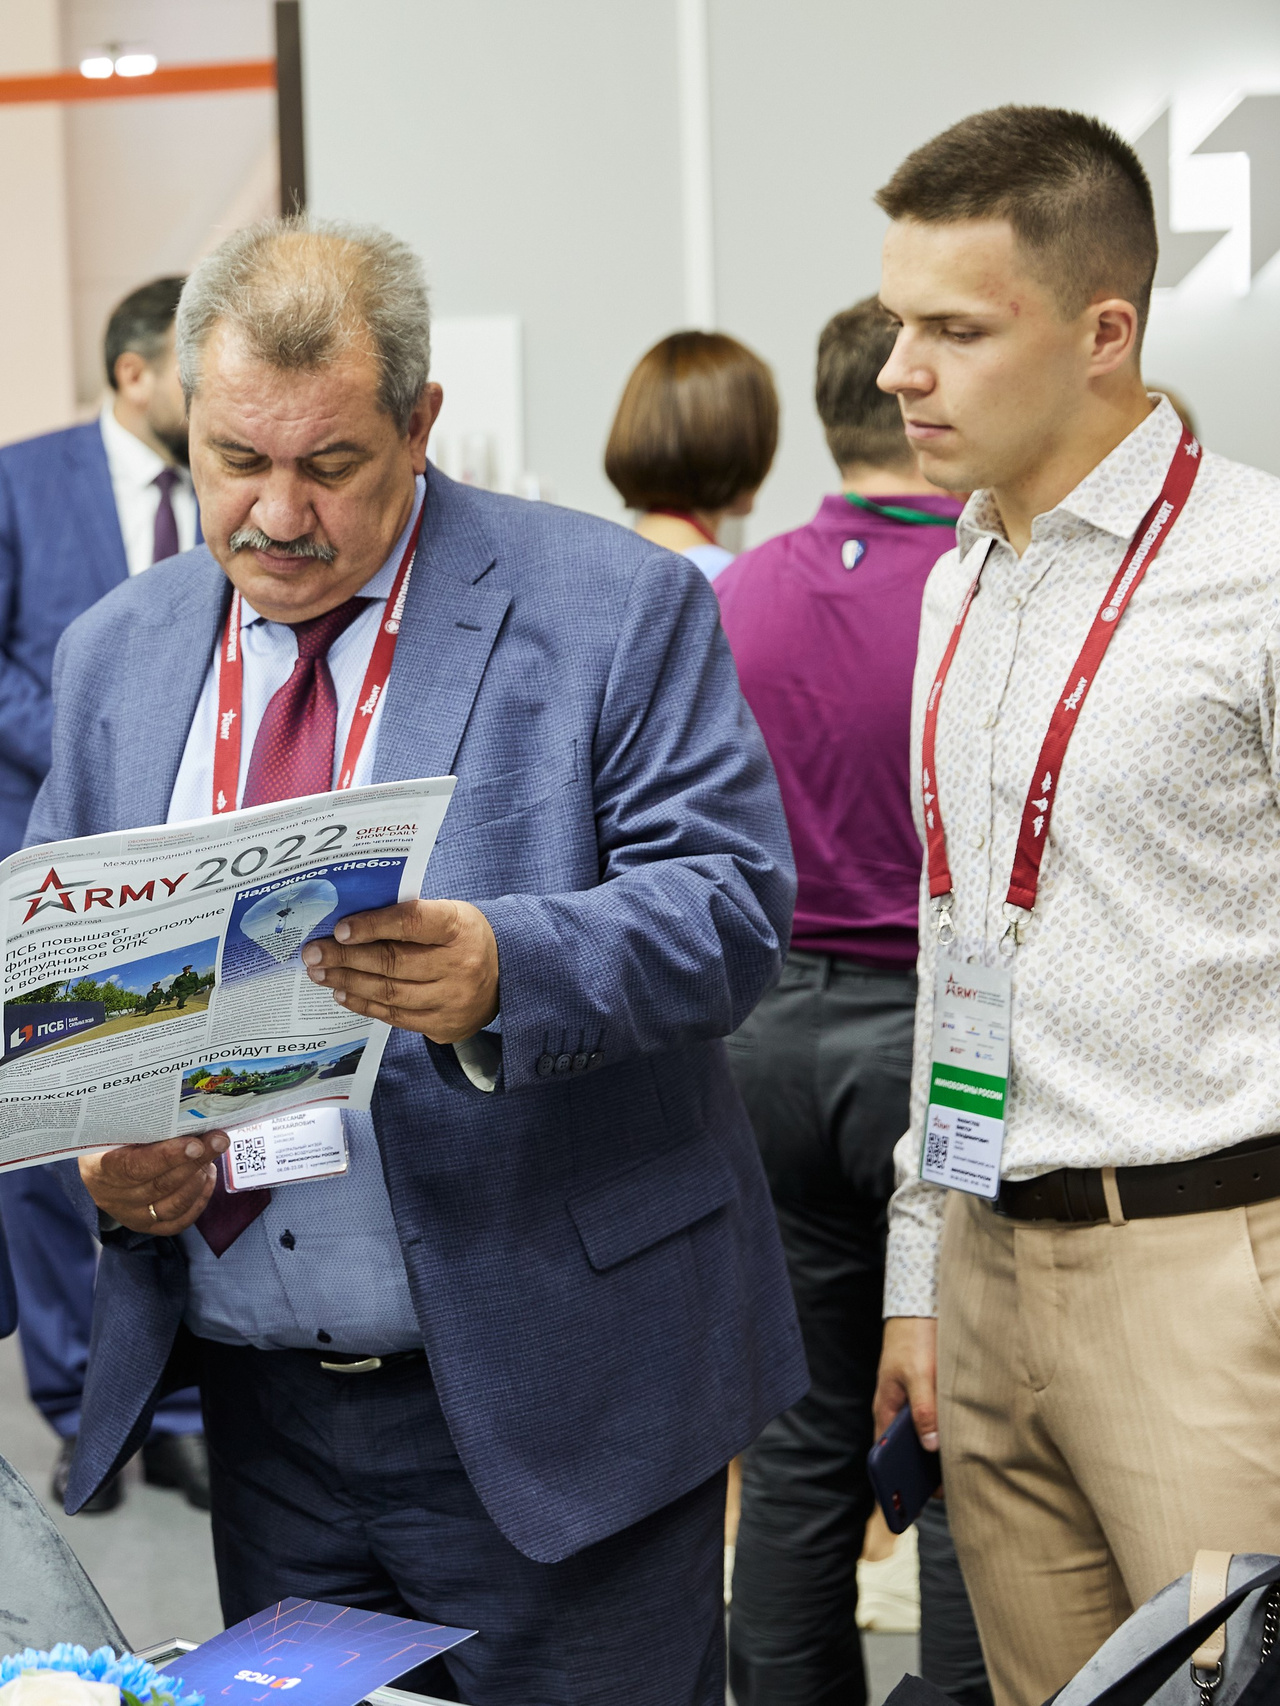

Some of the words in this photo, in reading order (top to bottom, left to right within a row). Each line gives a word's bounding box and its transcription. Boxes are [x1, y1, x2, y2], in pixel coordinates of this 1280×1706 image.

[1110, 500, 1174, 606] ROSOBORONEXPORT
[103, 849, 192, 868] Международный
[195, 822, 299, 854] военно-технический
[301, 813, 336, 826] форум
[352, 840, 371, 848] ДЕНЬ
[372, 837, 414, 845] ЧЕТВЕРТЫЙ
[355, 830, 418, 841] SHOW-DAILY
[356, 823, 419, 836] OFFICIAL
[20, 867, 189, 925] ARMY
[190, 824, 348, 891] 2022
[215, 870, 277, 893] ОФИЦИАЛЬНОЕ
[279, 857, 330, 874] ЕЖЕДНЕВНОЕ
[332, 850, 371, 860] ИЗДАНИЕ
[372, 846, 409, 854] ФОРУМА
[237, 868, 328, 901] Надежное
[333, 858, 402, 872] «Небо»
[4, 941, 107, 973] финансовое
[112, 907, 225, 945] благополучие
[36, 923, 63, 934] августа
[84, 917, 102, 926] года
[4, 951, 107, 984] сотрудников
[113, 937, 150, 954] ОПК
[6, 944, 37, 961] ПСБ
[42, 927, 130, 948] повышает
[4, 985, 14, 995] и
[19, 963, 90, 989] военных
[945, 972, 978, 999] ARMY
[37, 1021, 65, 1037] ПСБ
[102, 1060, 194, 1090] вездеходы
[198, 1043, 272, 1068] пройдут
[277, 1039, 327, 1055] везде
[272, 1119, 316, 1131] МИХАЙЛОВИЧ
[234, 1669, 276, 1685] ПСБ
